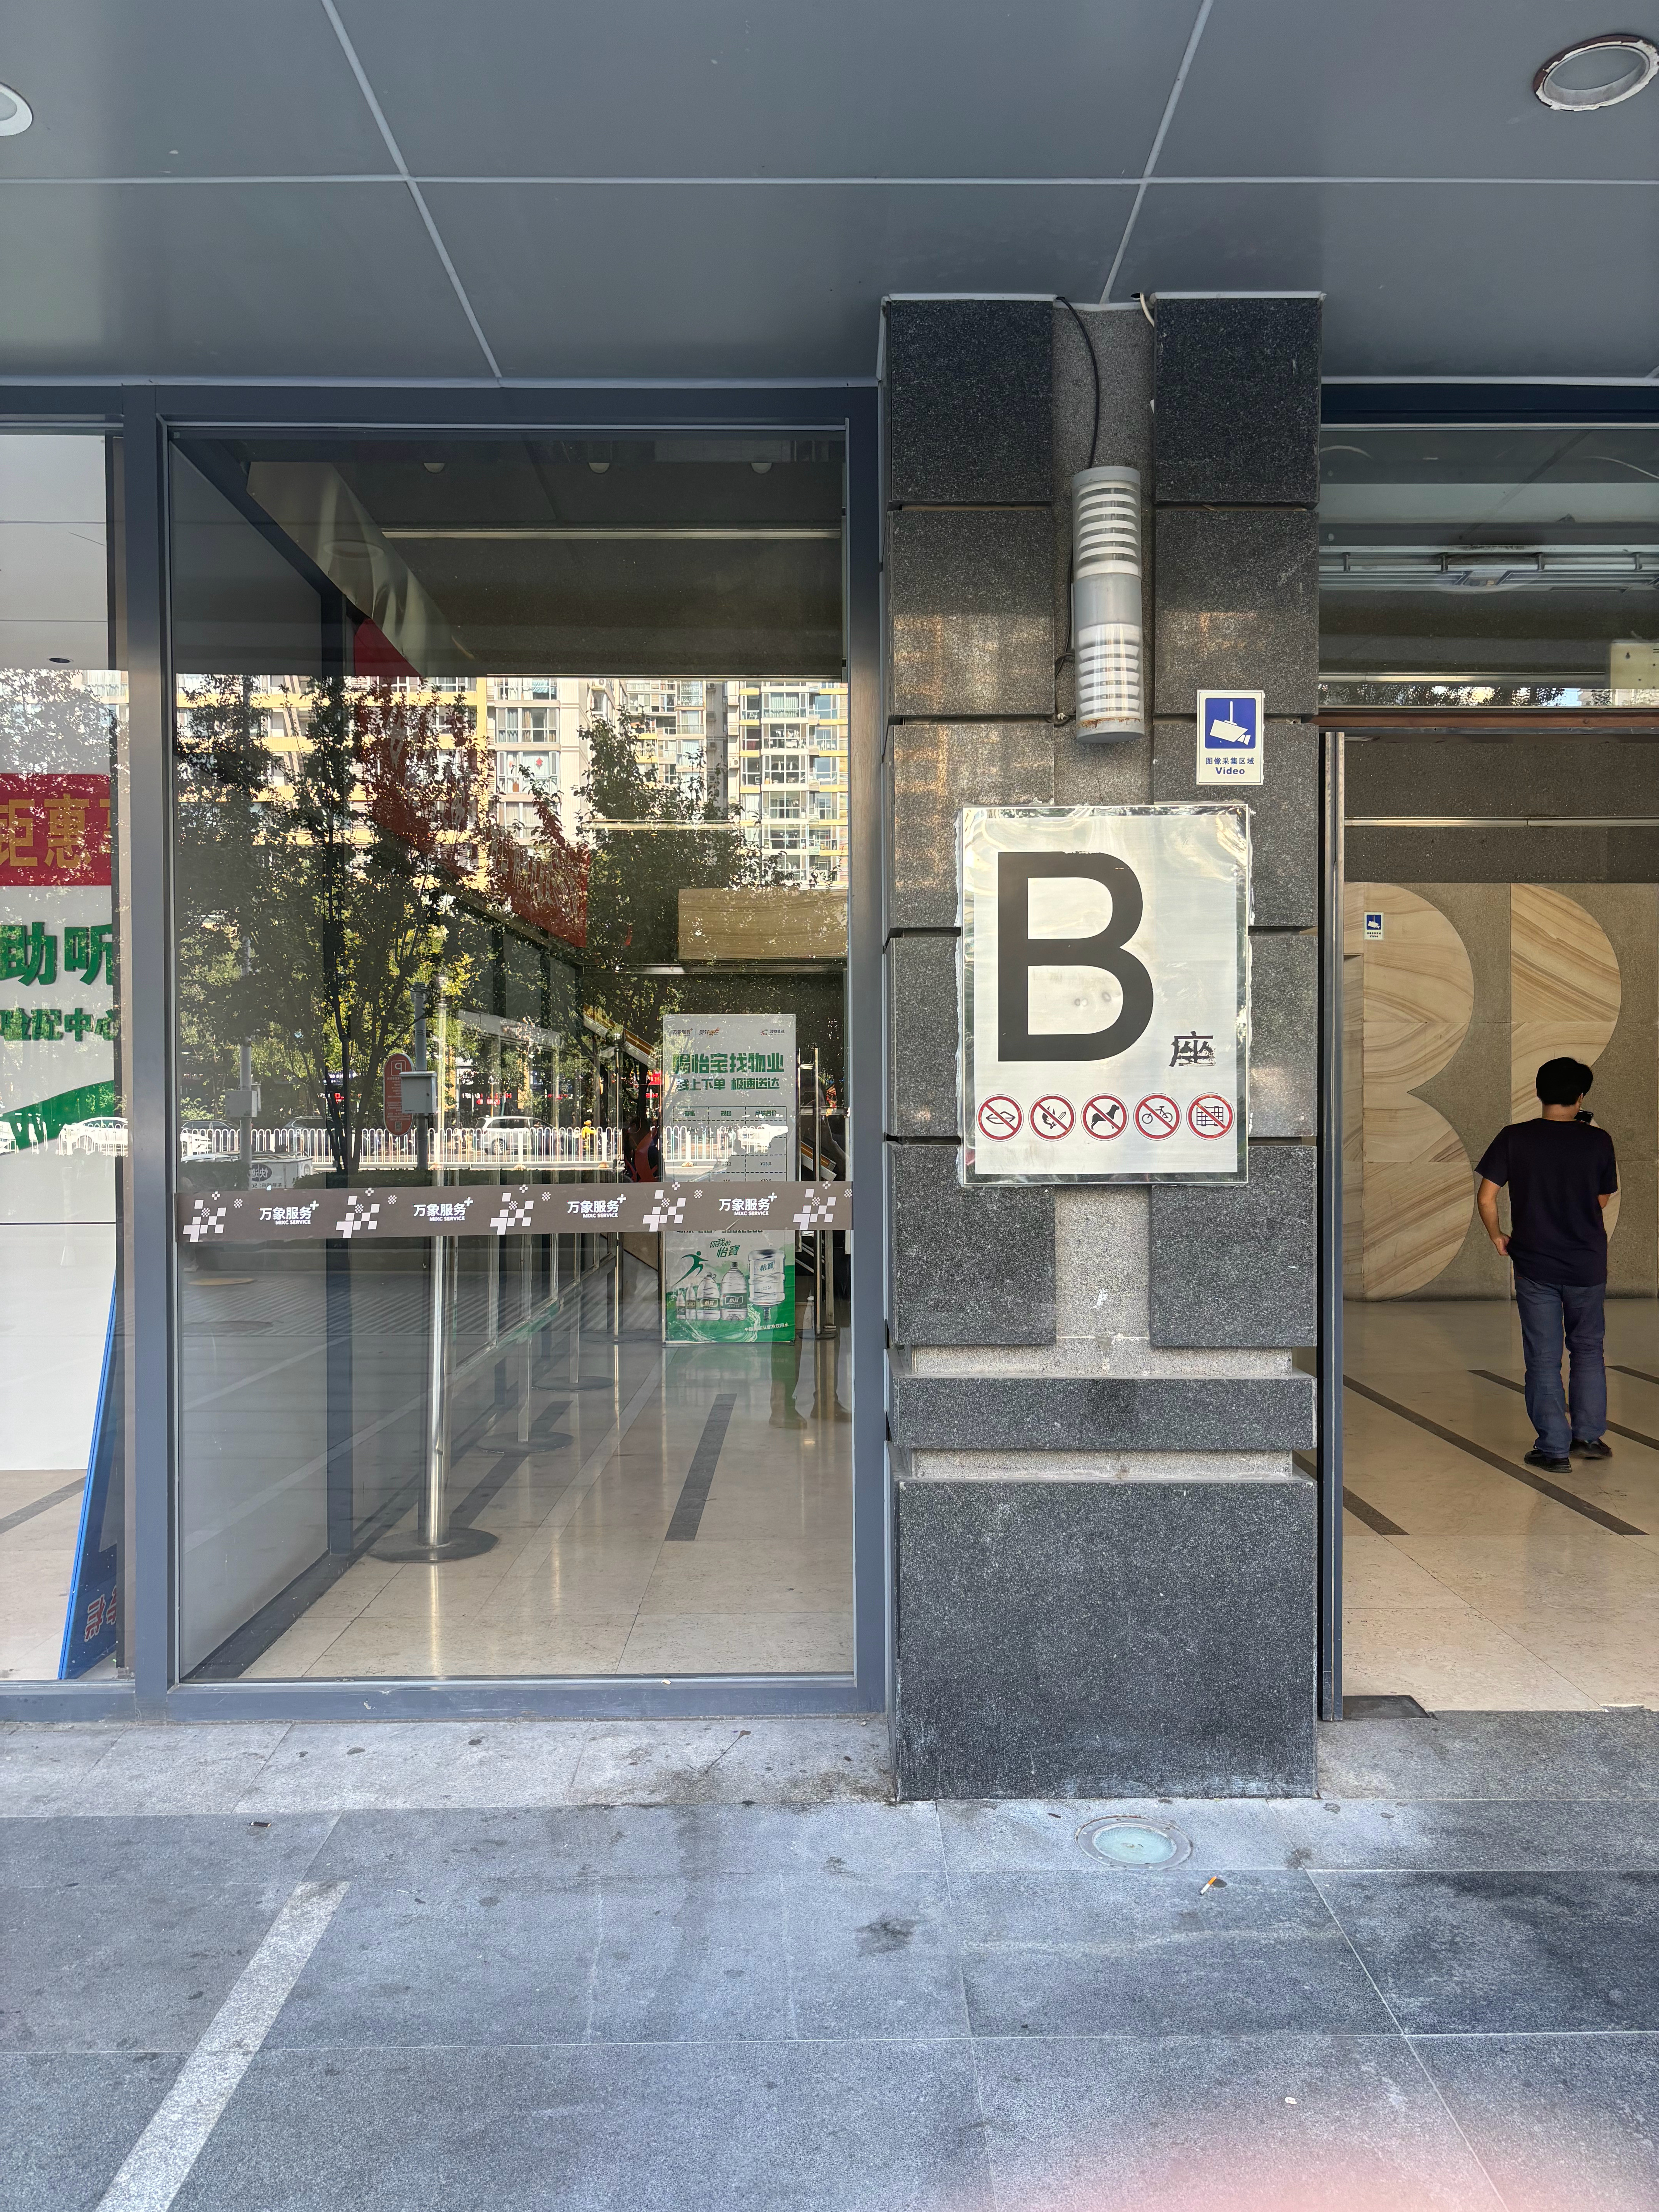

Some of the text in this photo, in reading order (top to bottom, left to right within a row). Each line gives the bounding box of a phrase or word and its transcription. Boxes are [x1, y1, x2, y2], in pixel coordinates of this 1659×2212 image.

[0, 793, 110, 869] 钜惠
[998, 852, 1154, 1062] B
[1169, 1030, 1216, 1067] 座
[731, 1077, 780, 1090] 极速送达
[709, 1238, 731, 1248] 你我的
